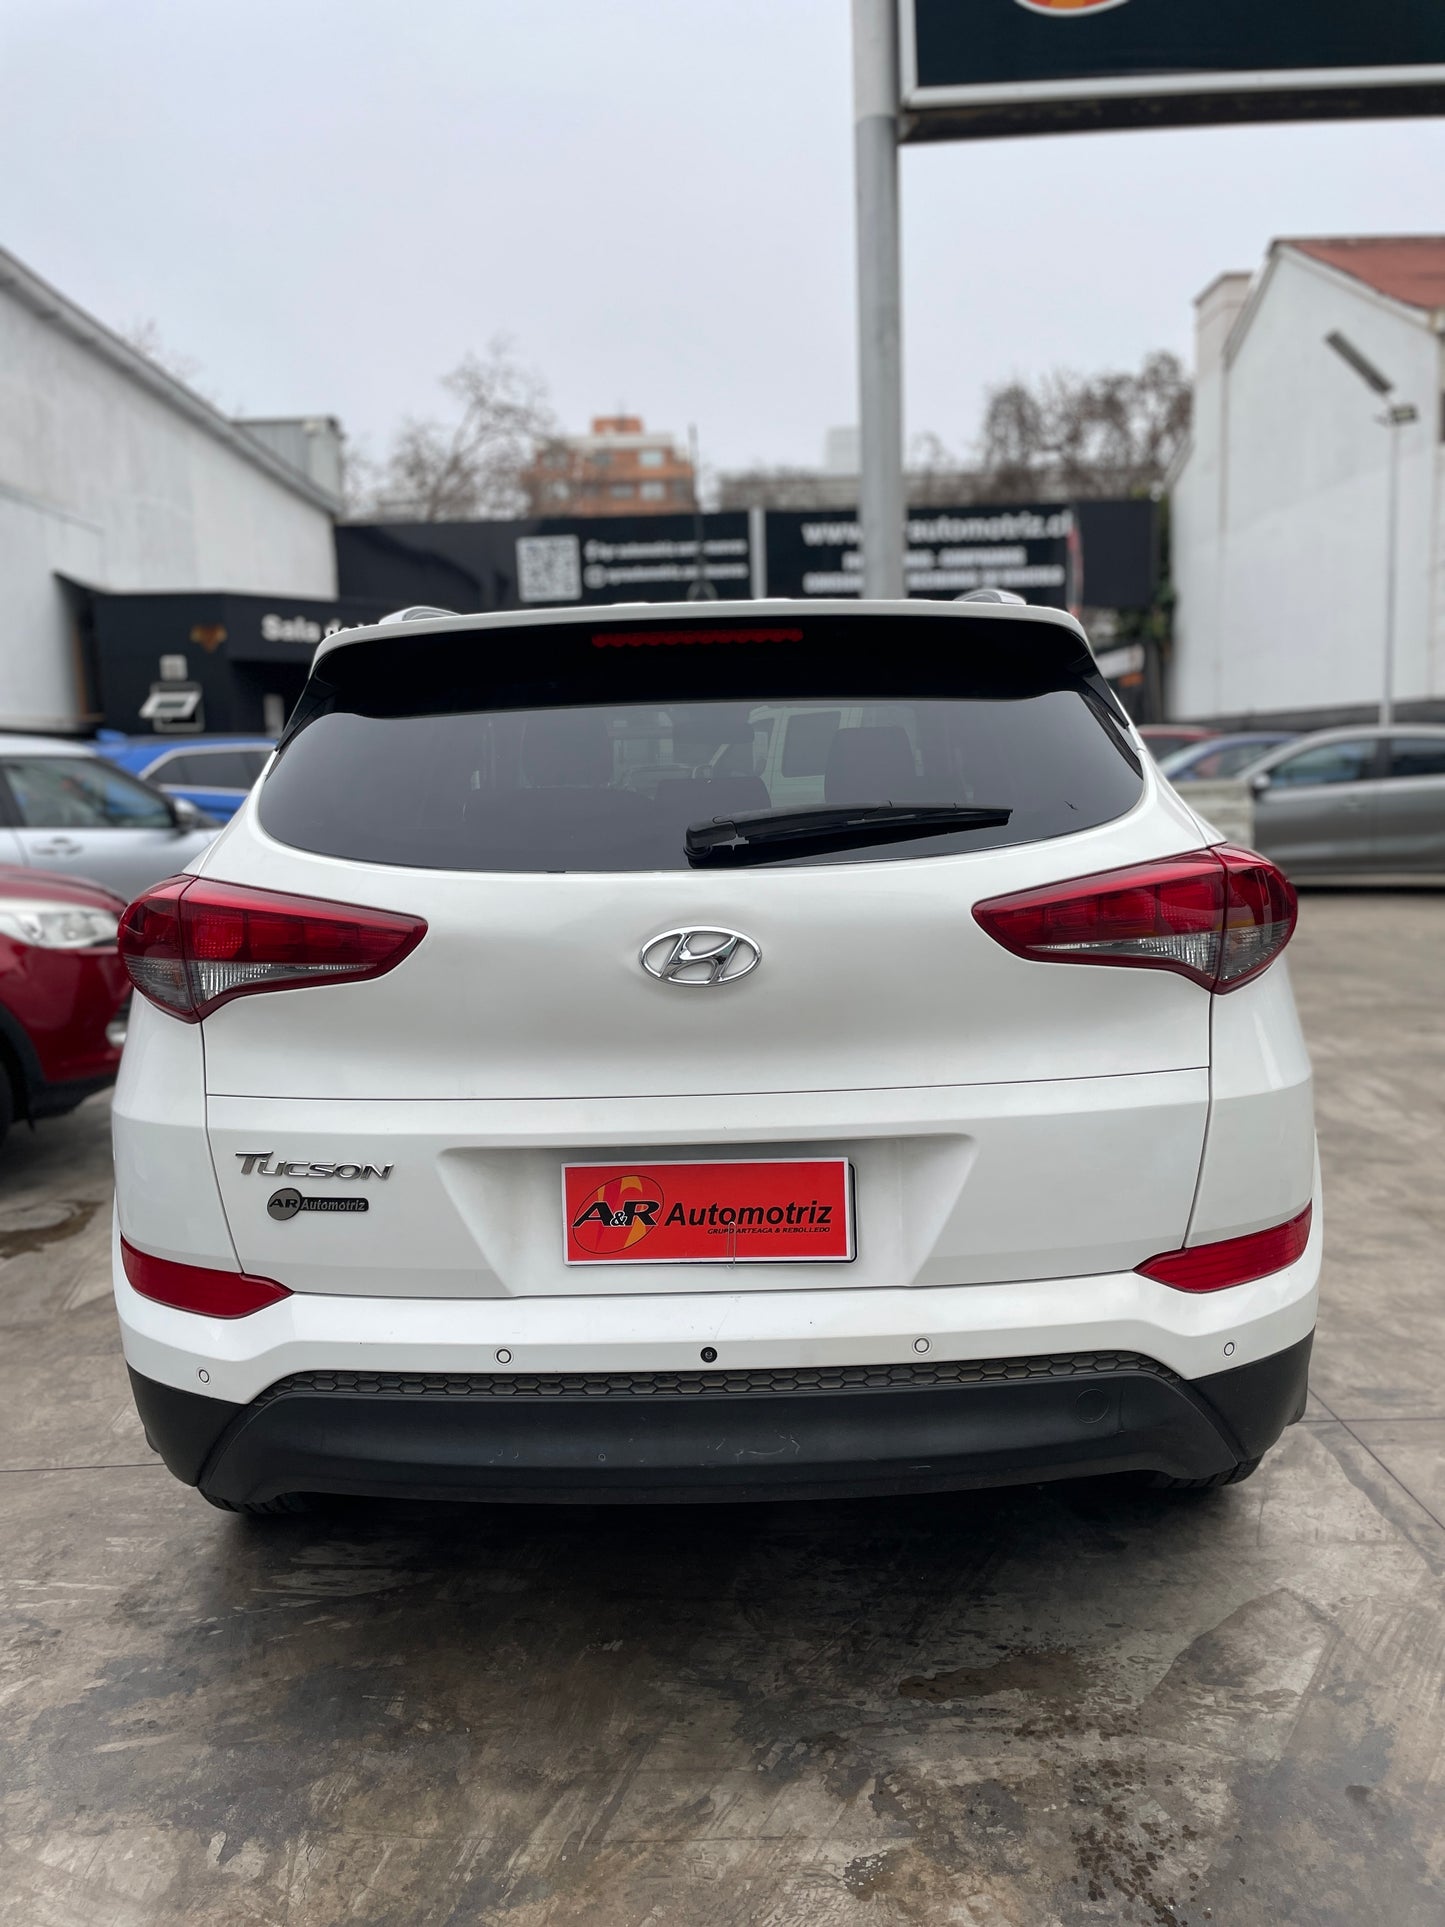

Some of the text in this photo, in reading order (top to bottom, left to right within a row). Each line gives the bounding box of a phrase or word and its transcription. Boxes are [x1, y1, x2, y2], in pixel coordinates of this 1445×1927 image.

[261, 613, 321, 643] Sala
[269, 1198, 366, 1212] AR Automotriz
[572, 1200, 833, 1227] A&R Automotriz
